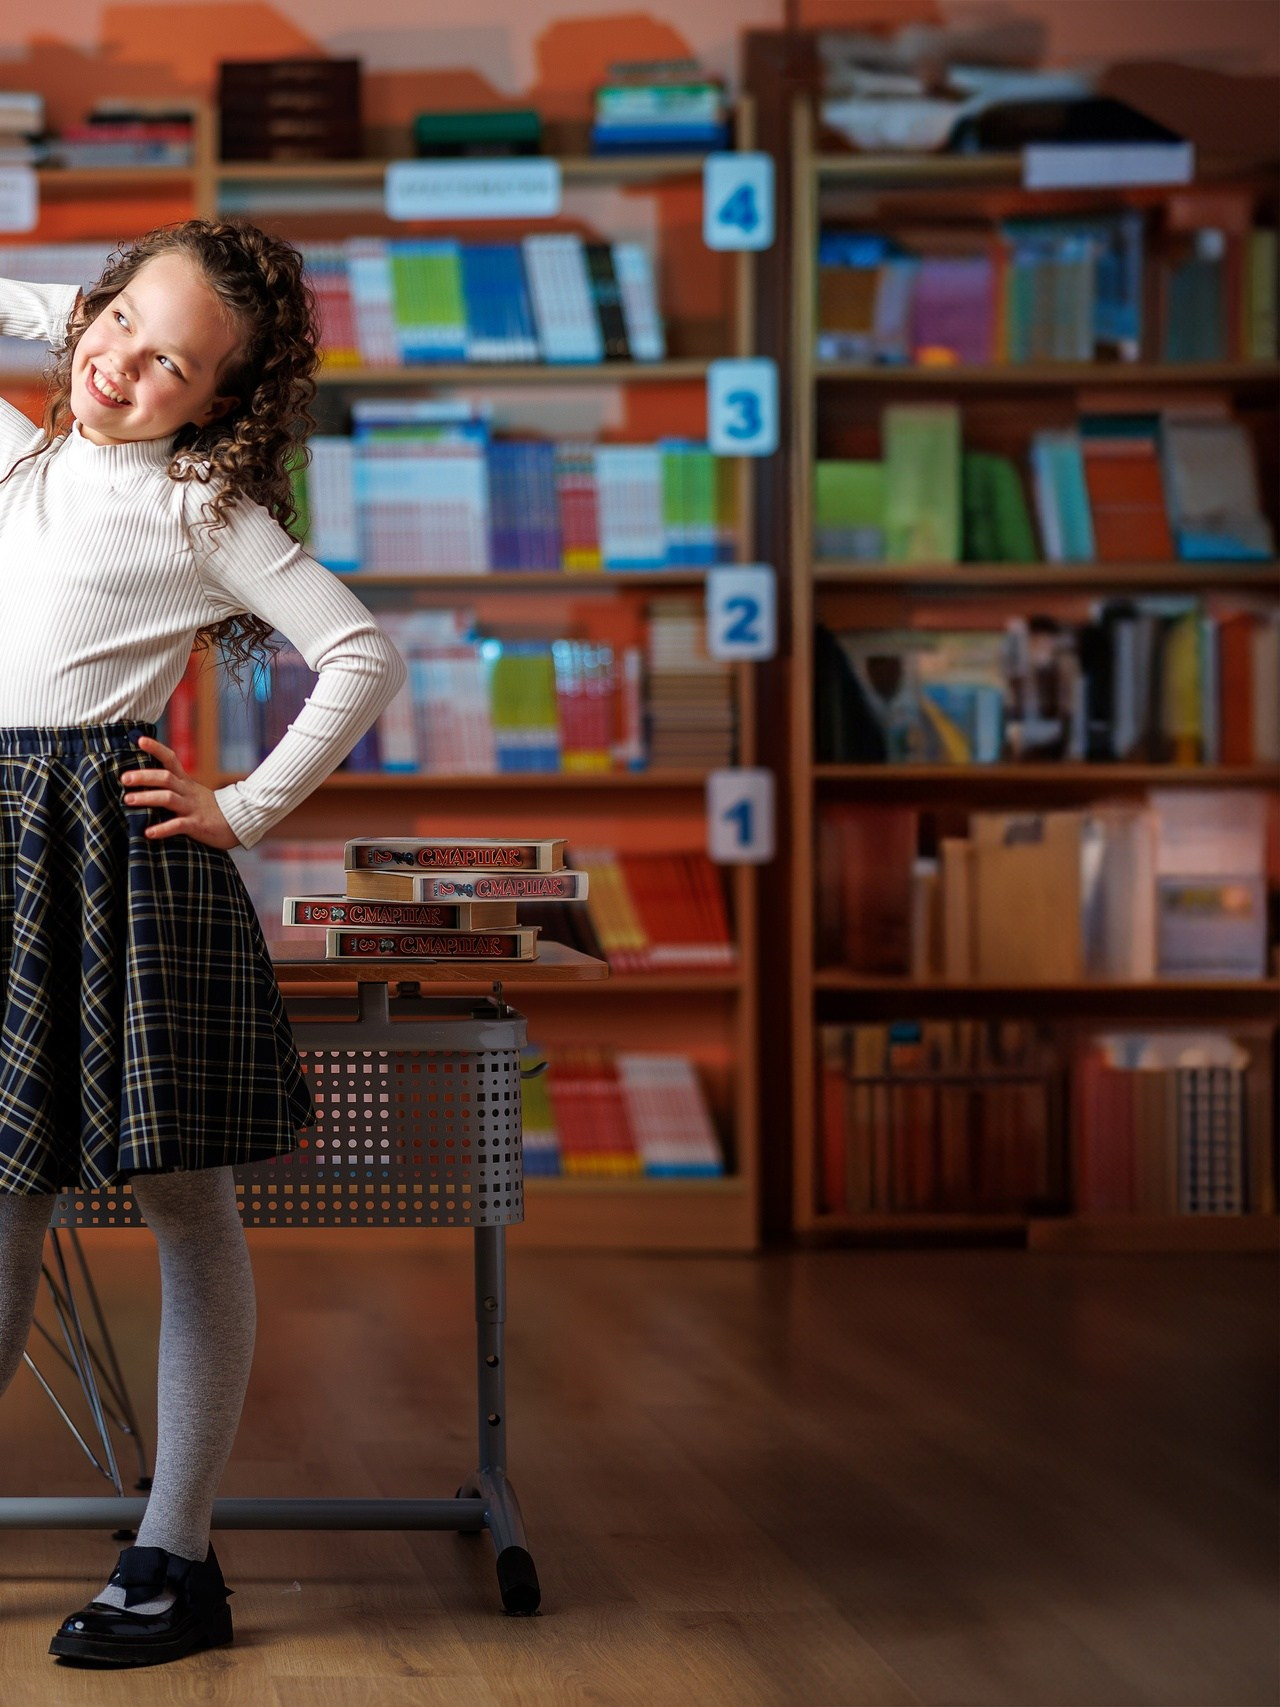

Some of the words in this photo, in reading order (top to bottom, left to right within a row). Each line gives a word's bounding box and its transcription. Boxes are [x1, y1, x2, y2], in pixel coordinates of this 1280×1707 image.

[715, 184, 759, 234] 4
[726, 390, 763, 440] 3
[724, 596, 760, 643] 2
[724, 798, 753, 846] 1
[374, 850, 393, 864] 2
[417, 848, 522, 867] С.МАРШАК
[439, 882, 455, 896] 2
[476, 878, 563, 898] С.МАРШАК
[312, 907, 328, 920] 3
[350, 906, 443, 926] С.МАРШАК
[400, 936, 503, 956] С.МАРШАК
